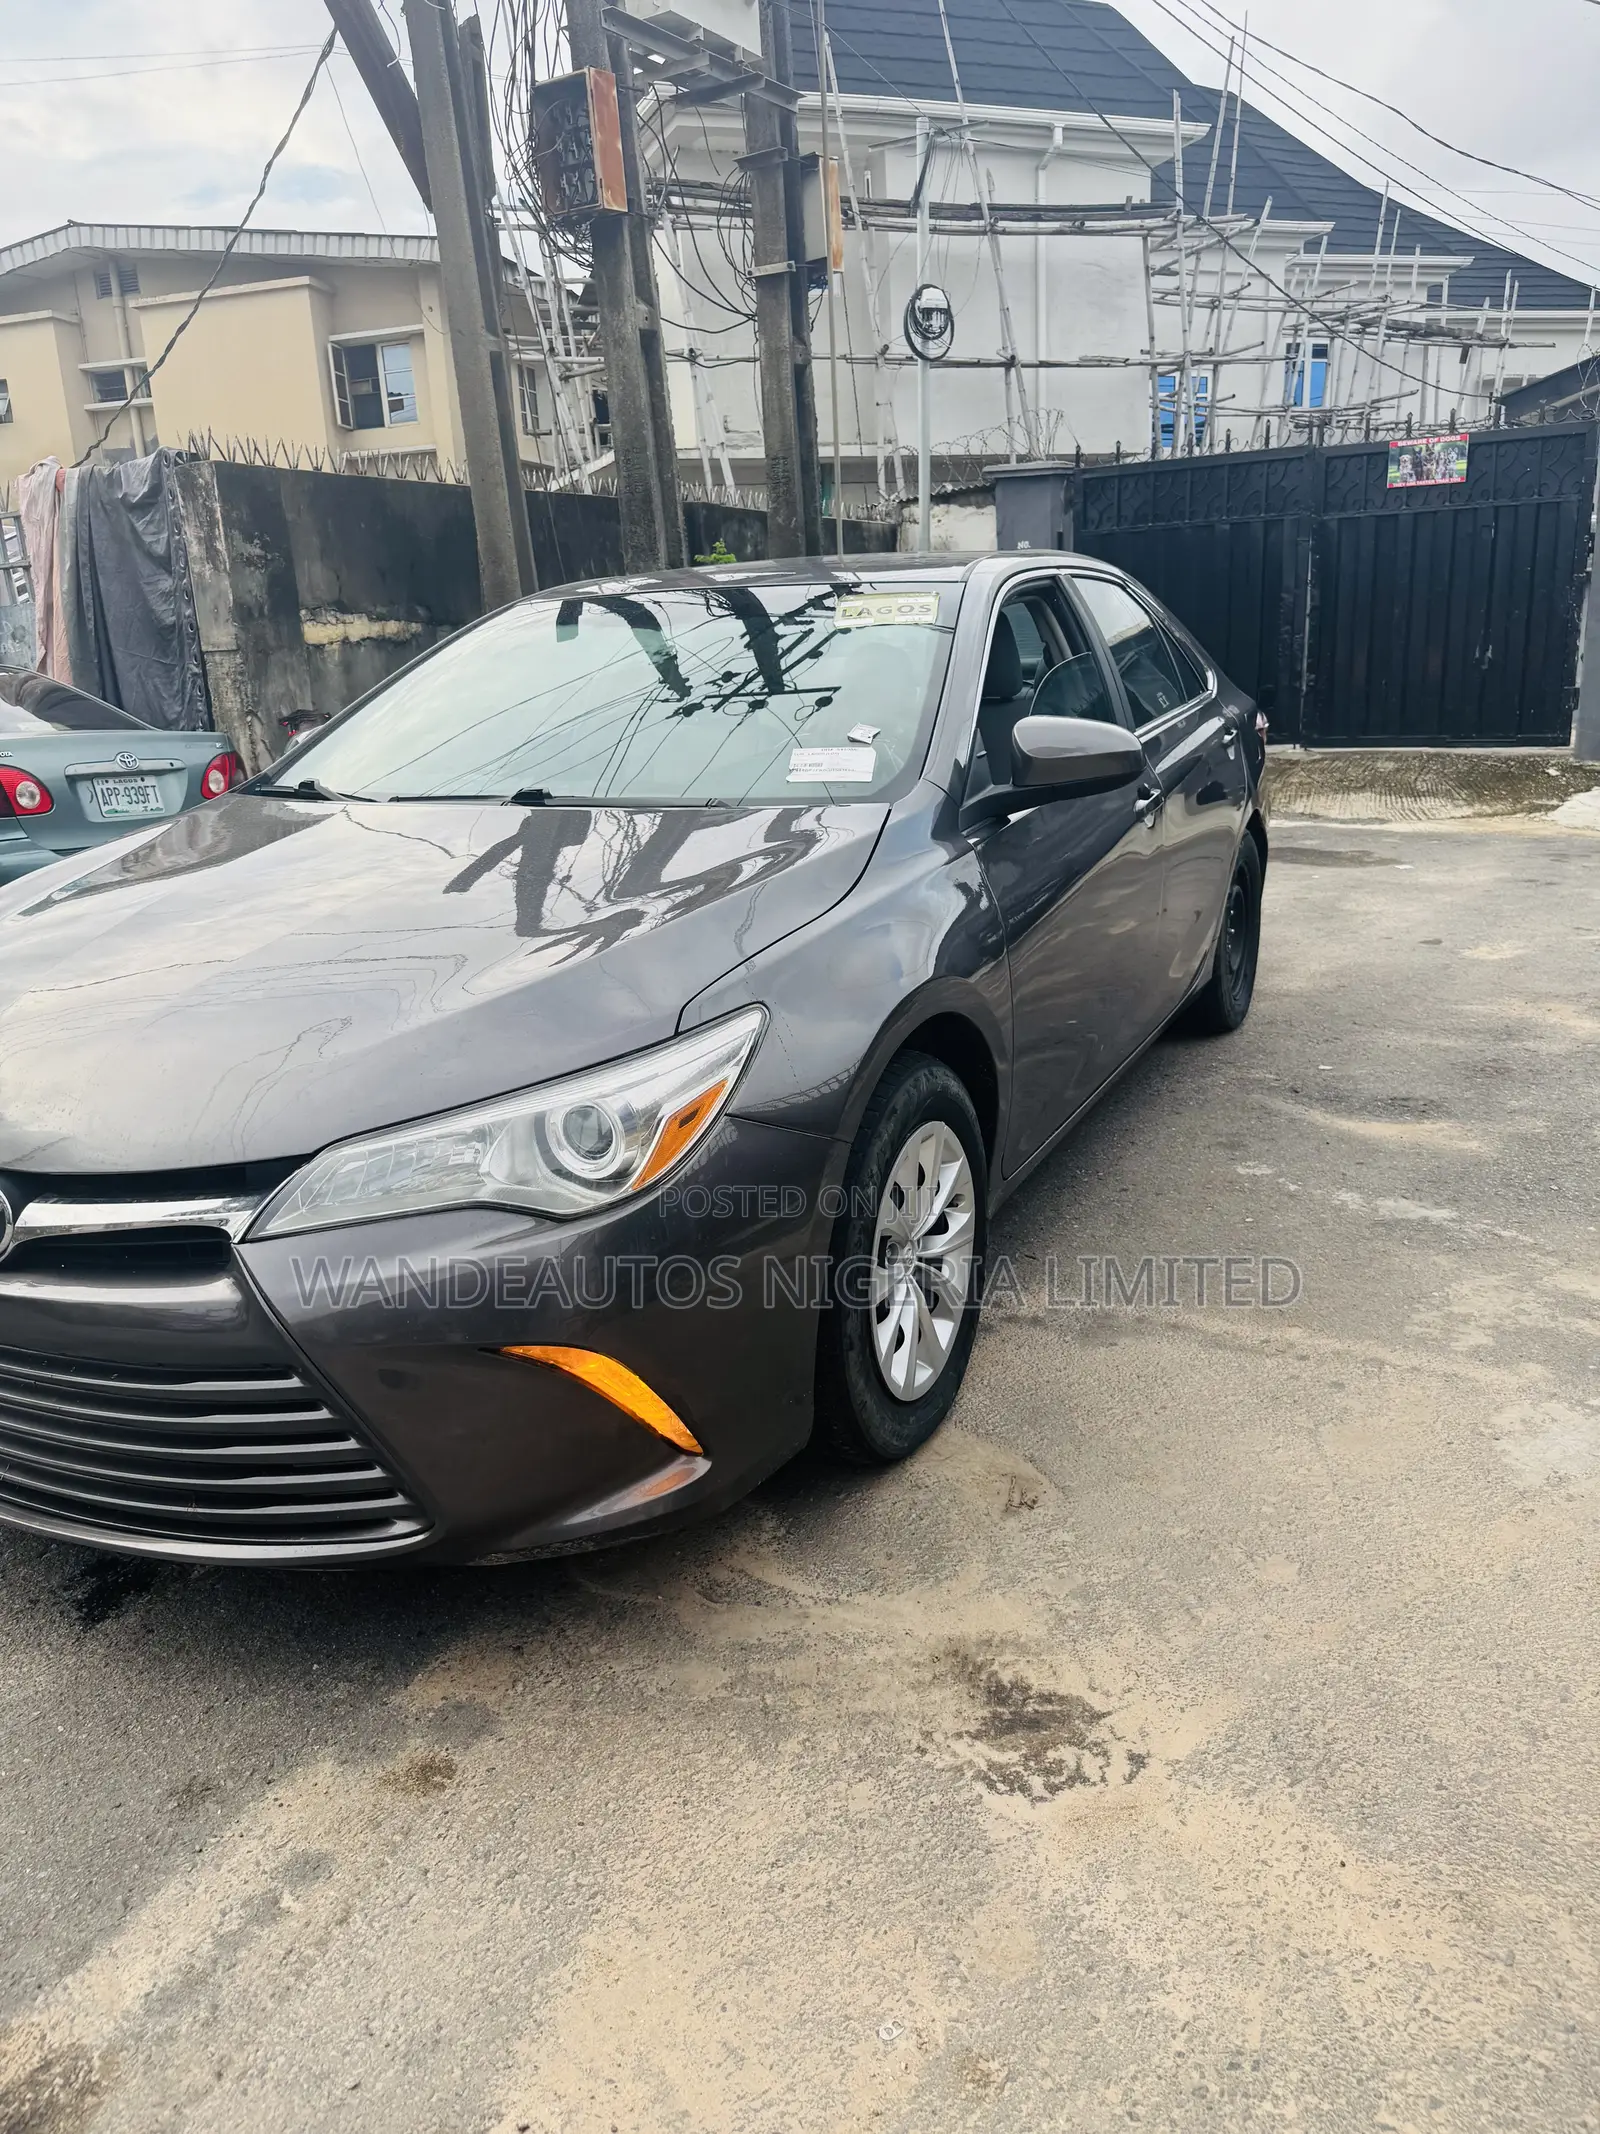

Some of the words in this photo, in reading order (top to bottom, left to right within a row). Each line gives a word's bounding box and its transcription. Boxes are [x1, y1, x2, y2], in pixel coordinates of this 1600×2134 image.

[1397, 438, 1427, 447] BEWARE
[1428, 436, 1439, 444] OF
[1440, 435, 1461, 443] DOGS
[841, 604, 932, 618] LAGOS
[100, 785, 159, 807] APP-939FT
